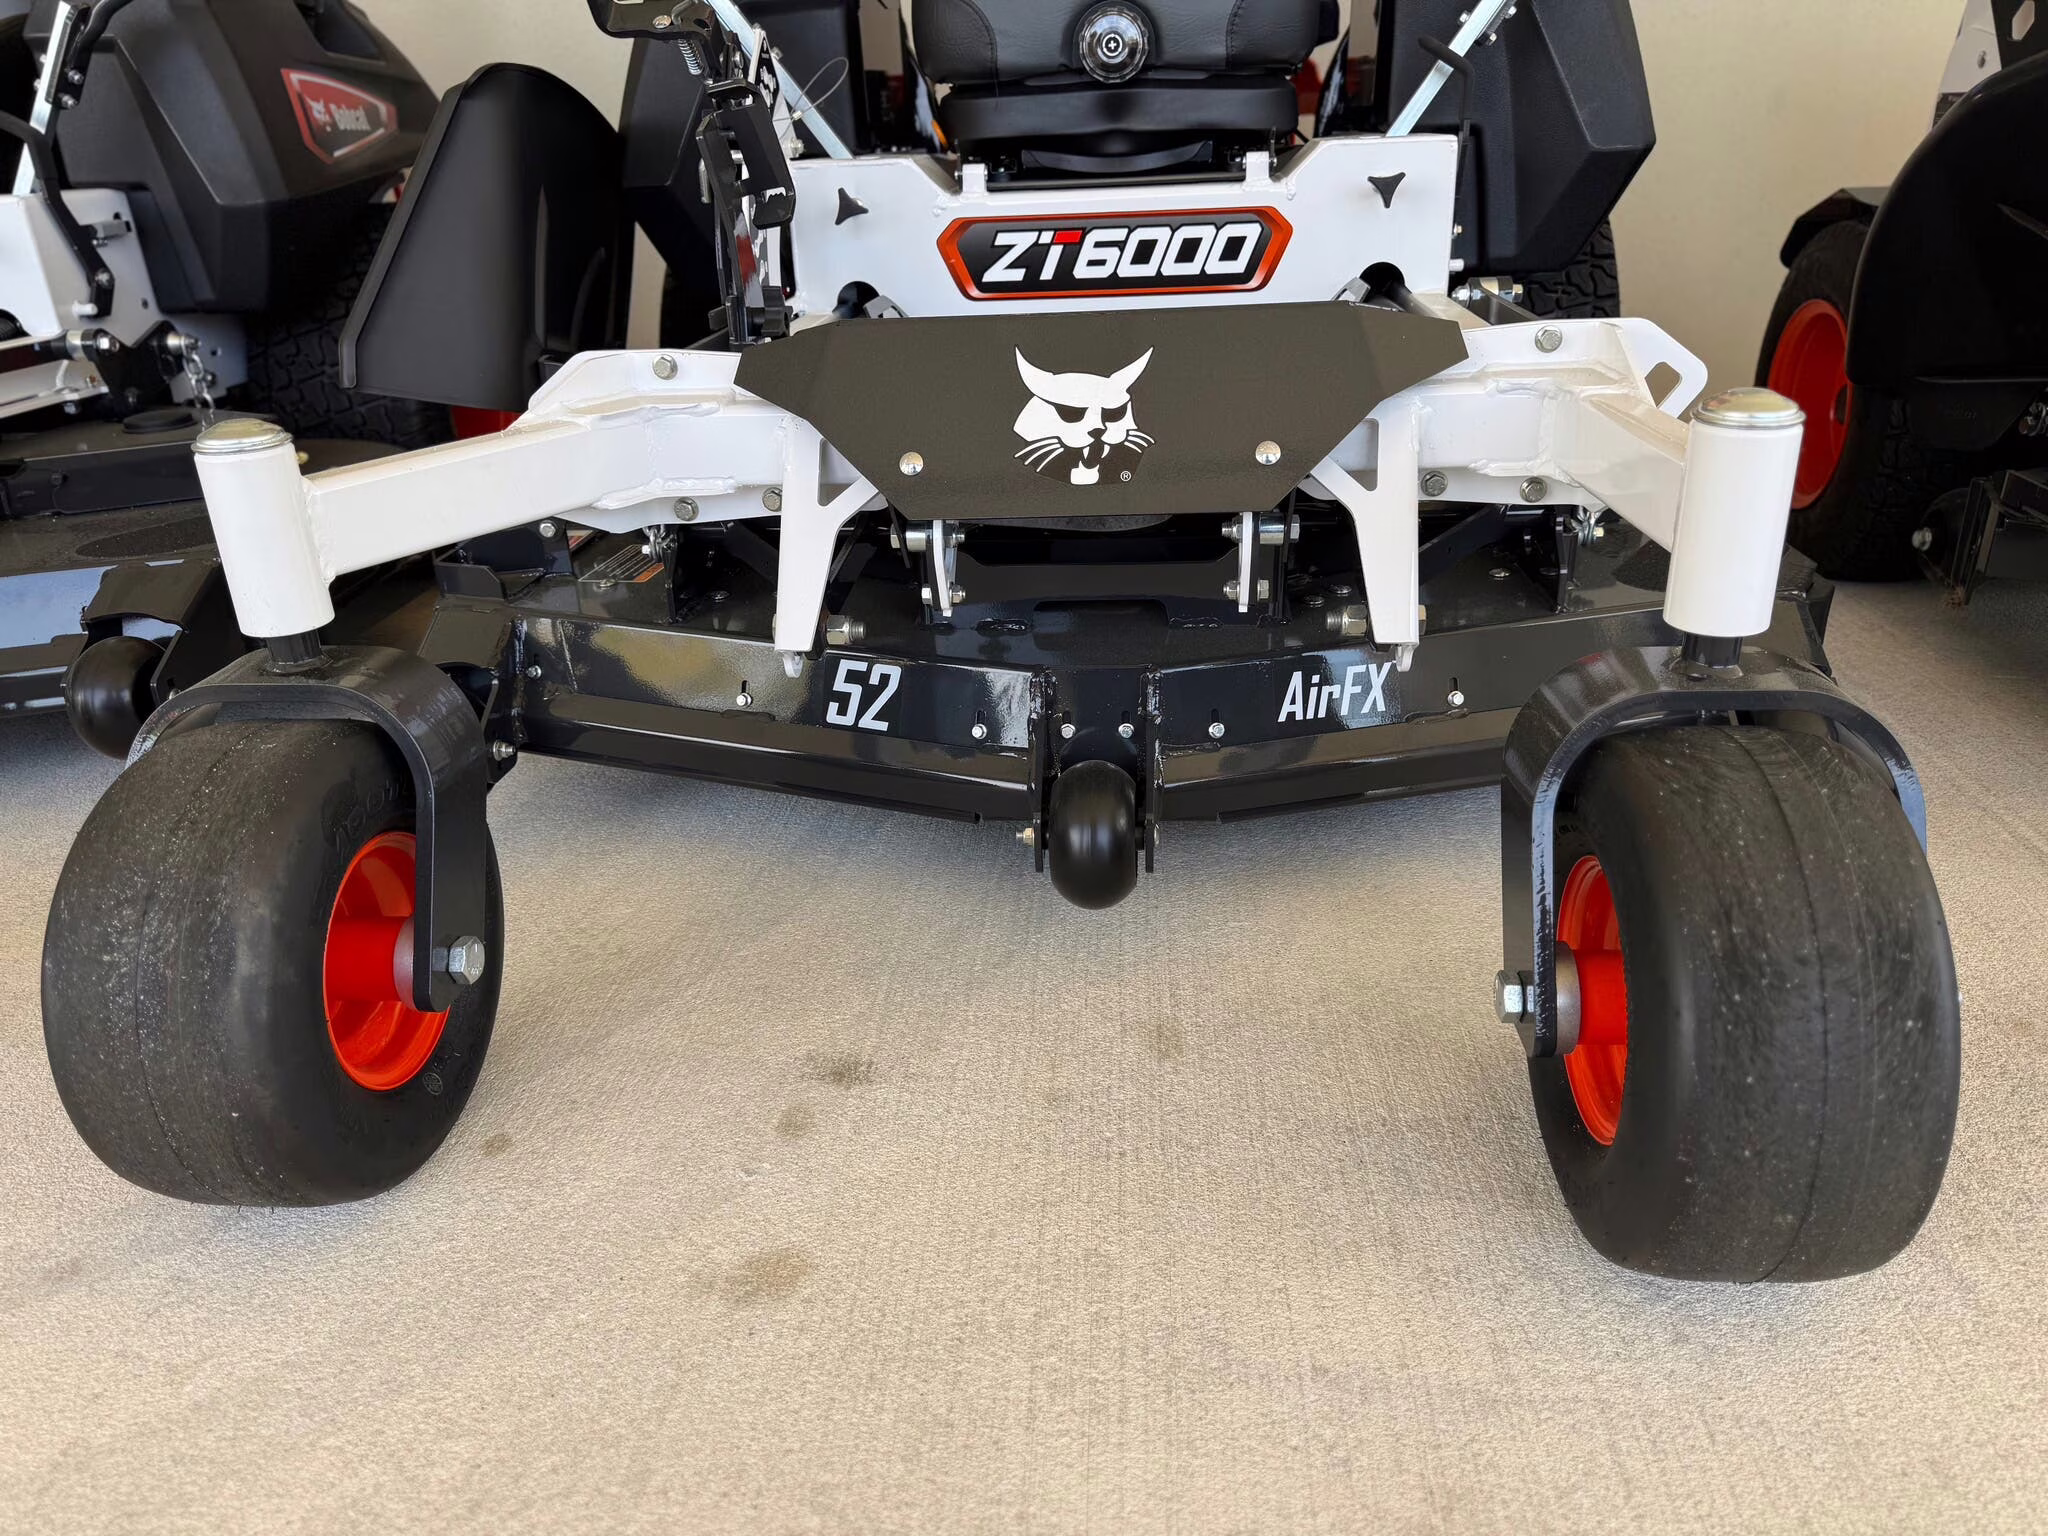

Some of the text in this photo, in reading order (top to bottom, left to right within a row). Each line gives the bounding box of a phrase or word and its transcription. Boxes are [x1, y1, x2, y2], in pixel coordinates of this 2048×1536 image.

[981, 222, 1262, 283] ZT6000
[826, 659, 902, 732] 52
[1277, 661, 1393, 723] AirFX
